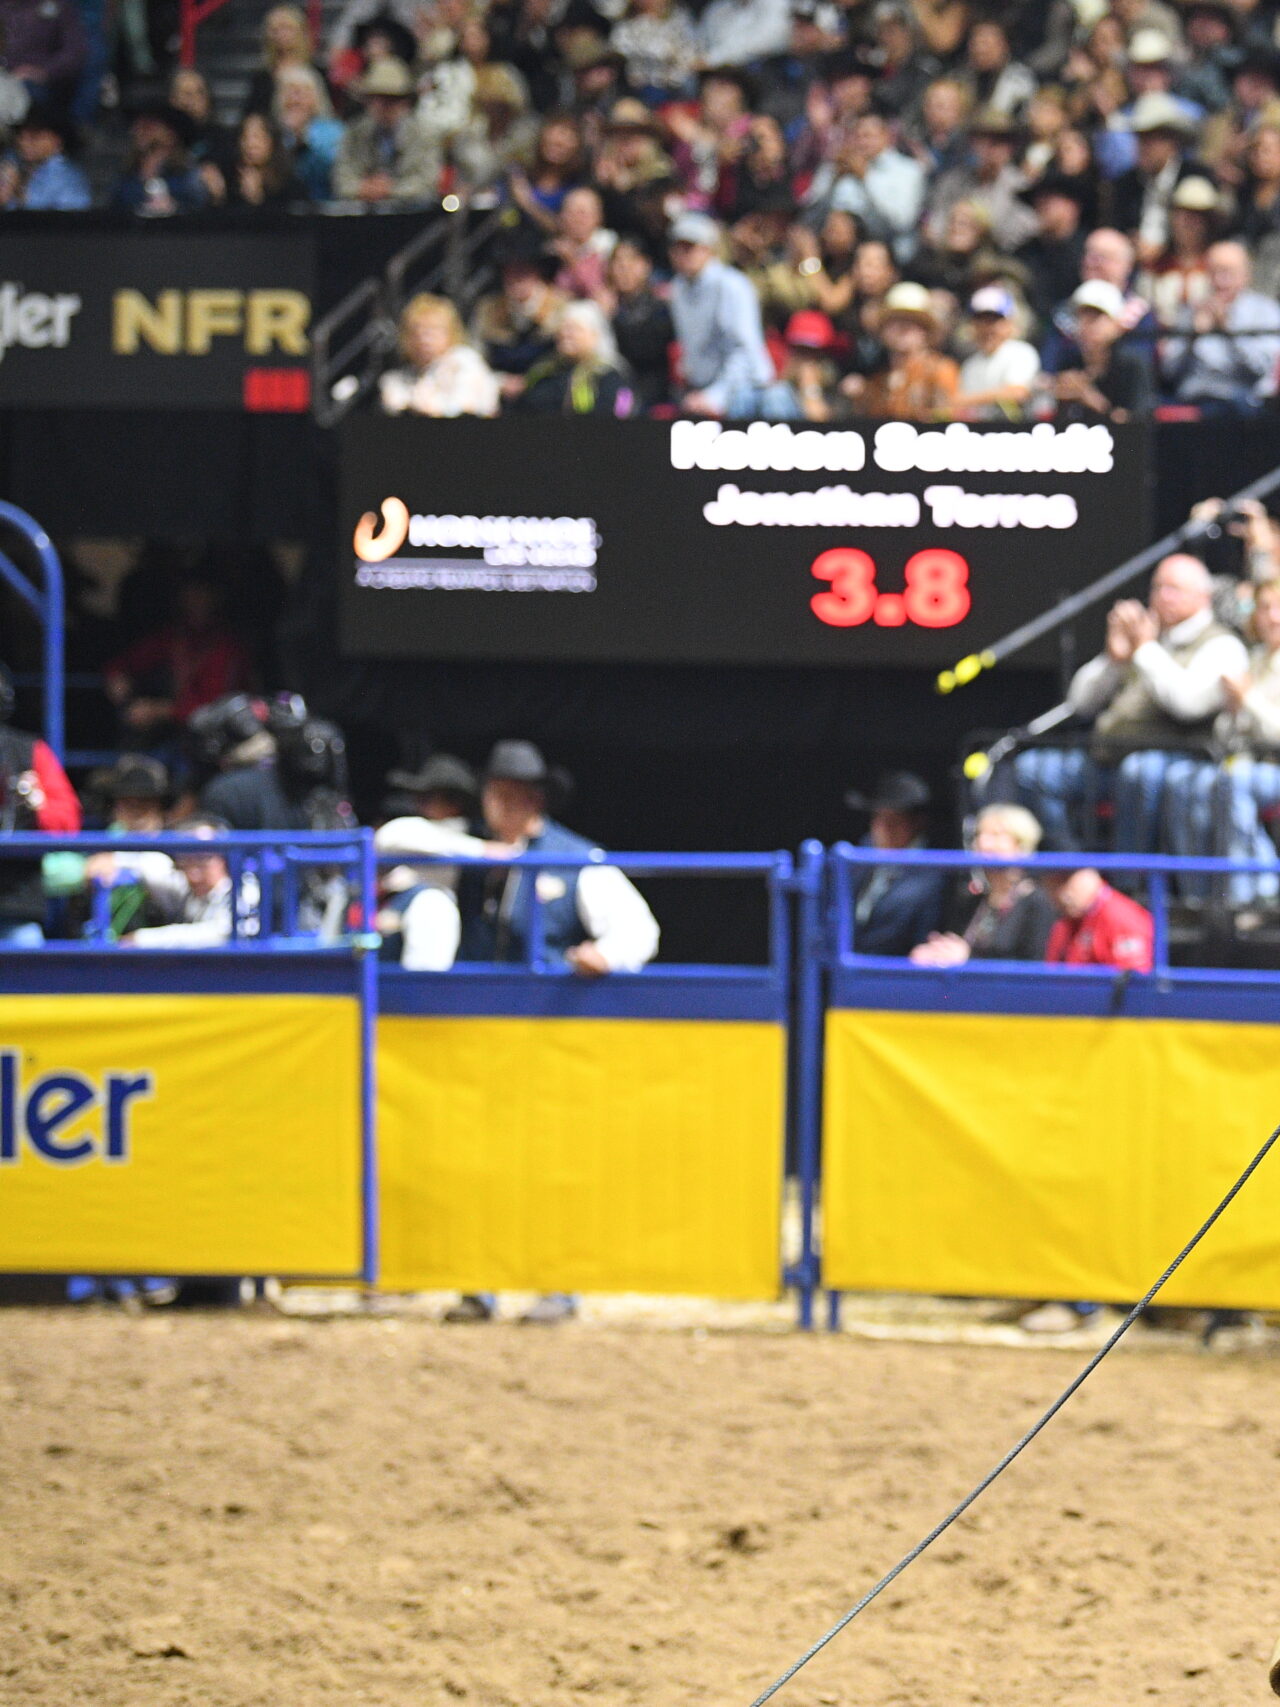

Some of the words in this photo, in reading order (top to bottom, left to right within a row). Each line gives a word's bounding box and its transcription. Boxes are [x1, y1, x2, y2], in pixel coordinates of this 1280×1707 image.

[0, 281, 82, 360] ler
[112, 288, 312, 355] NFR
[810, 547, 971, 628] 3.8
[0, 1048, 152, 1165] ler
